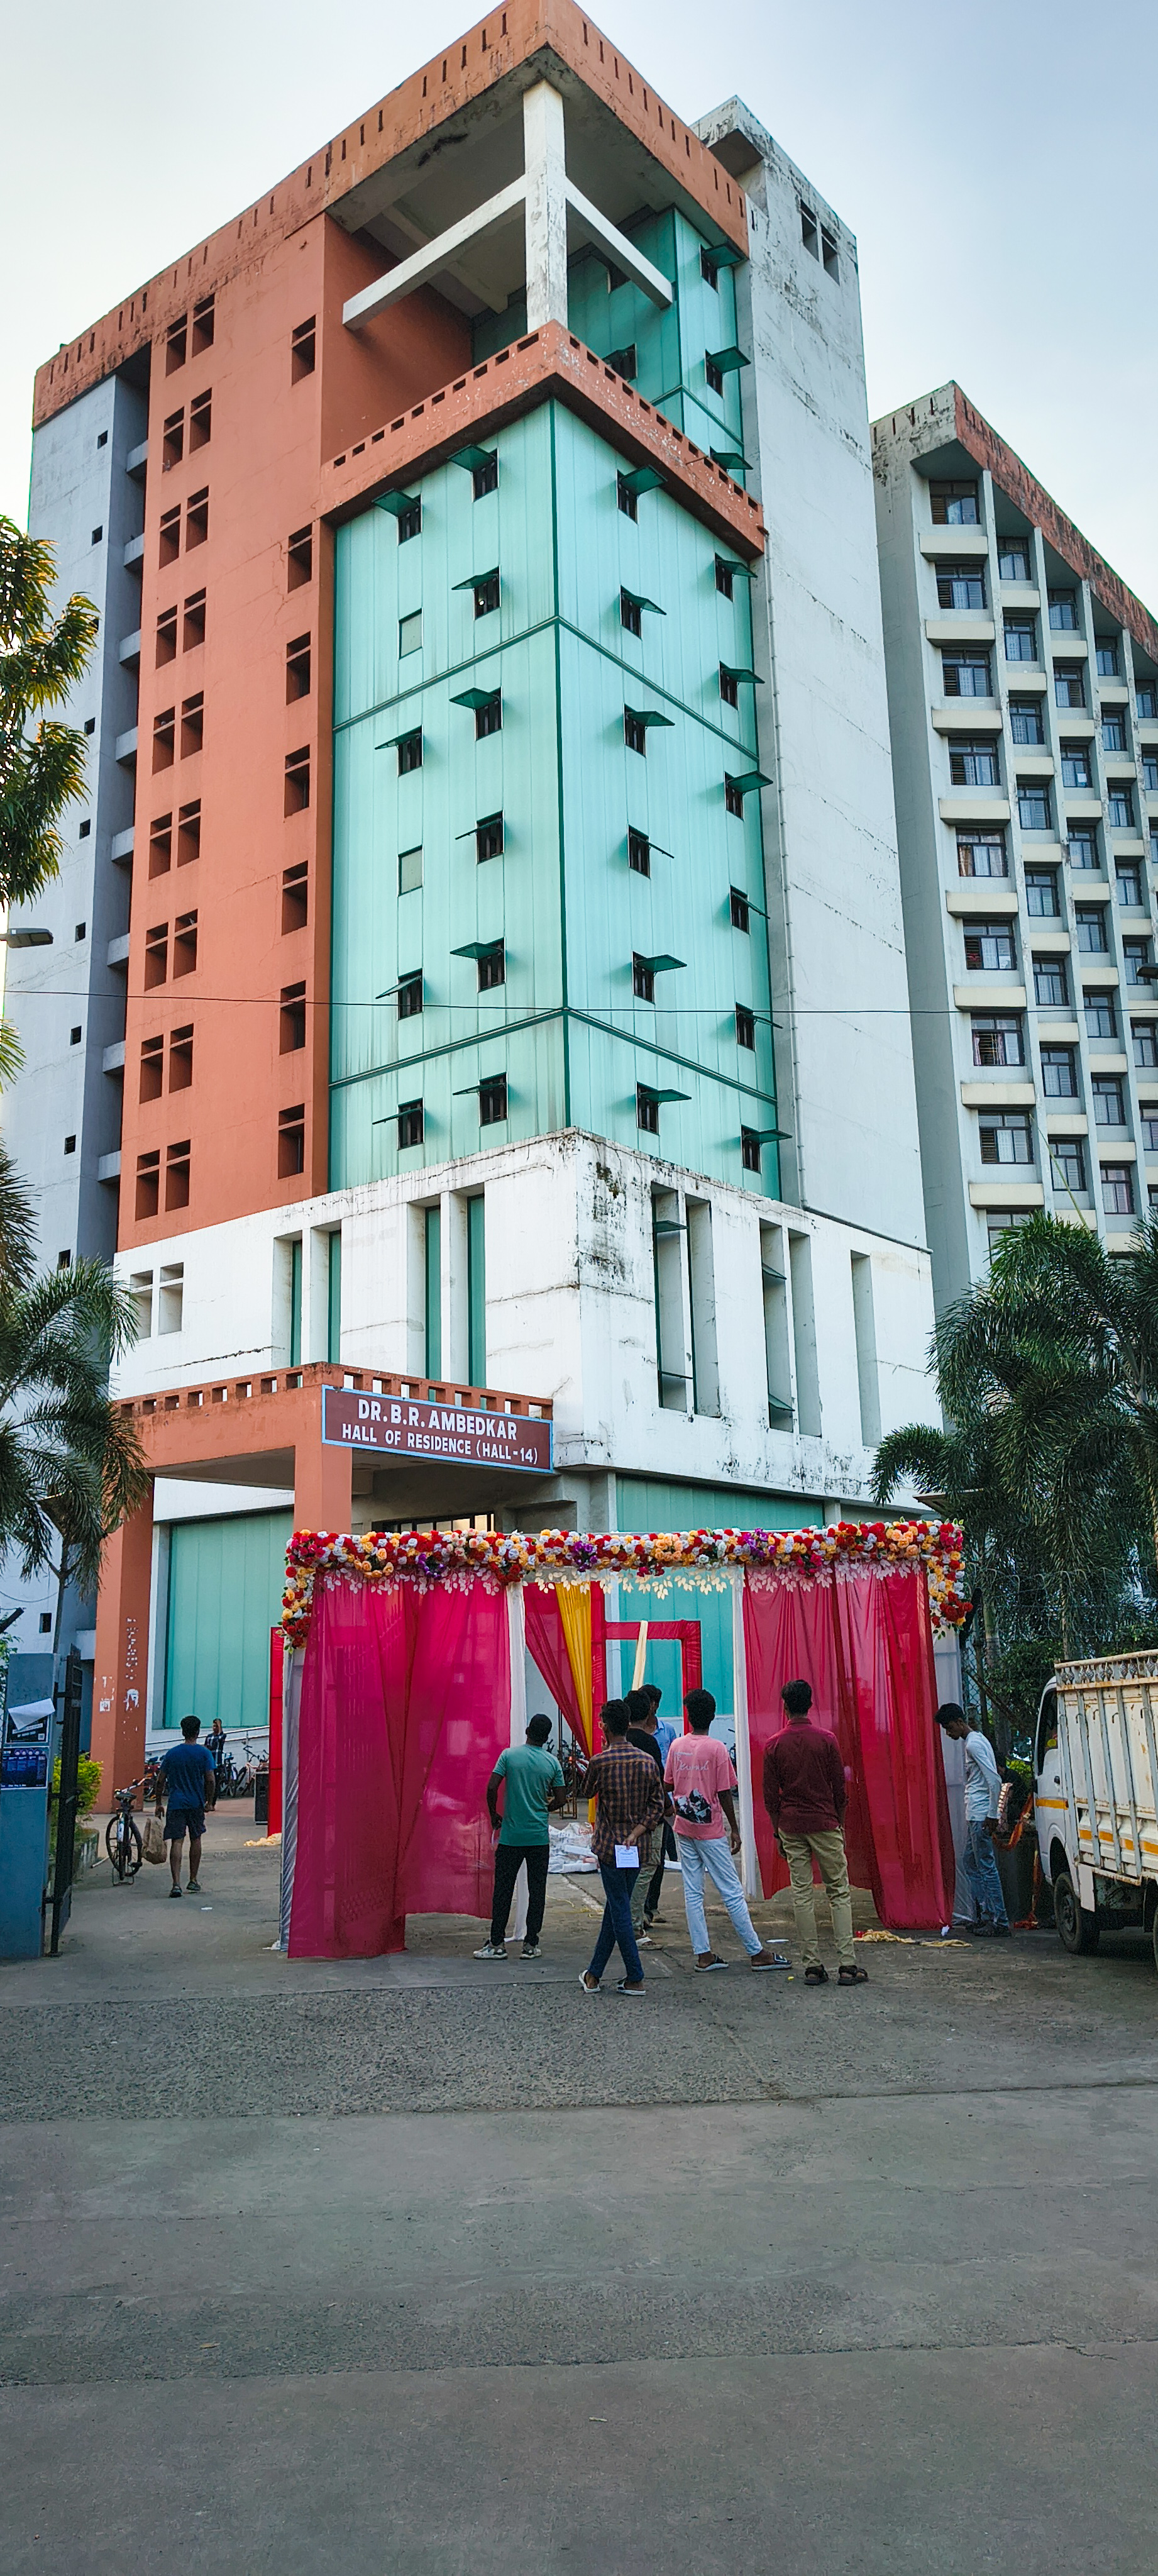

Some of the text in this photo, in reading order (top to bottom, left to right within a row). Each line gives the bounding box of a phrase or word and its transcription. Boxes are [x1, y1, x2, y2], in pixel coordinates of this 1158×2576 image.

[343, 1423, 538, 1464] HALL OF RESIDENCE (HALL-14)
